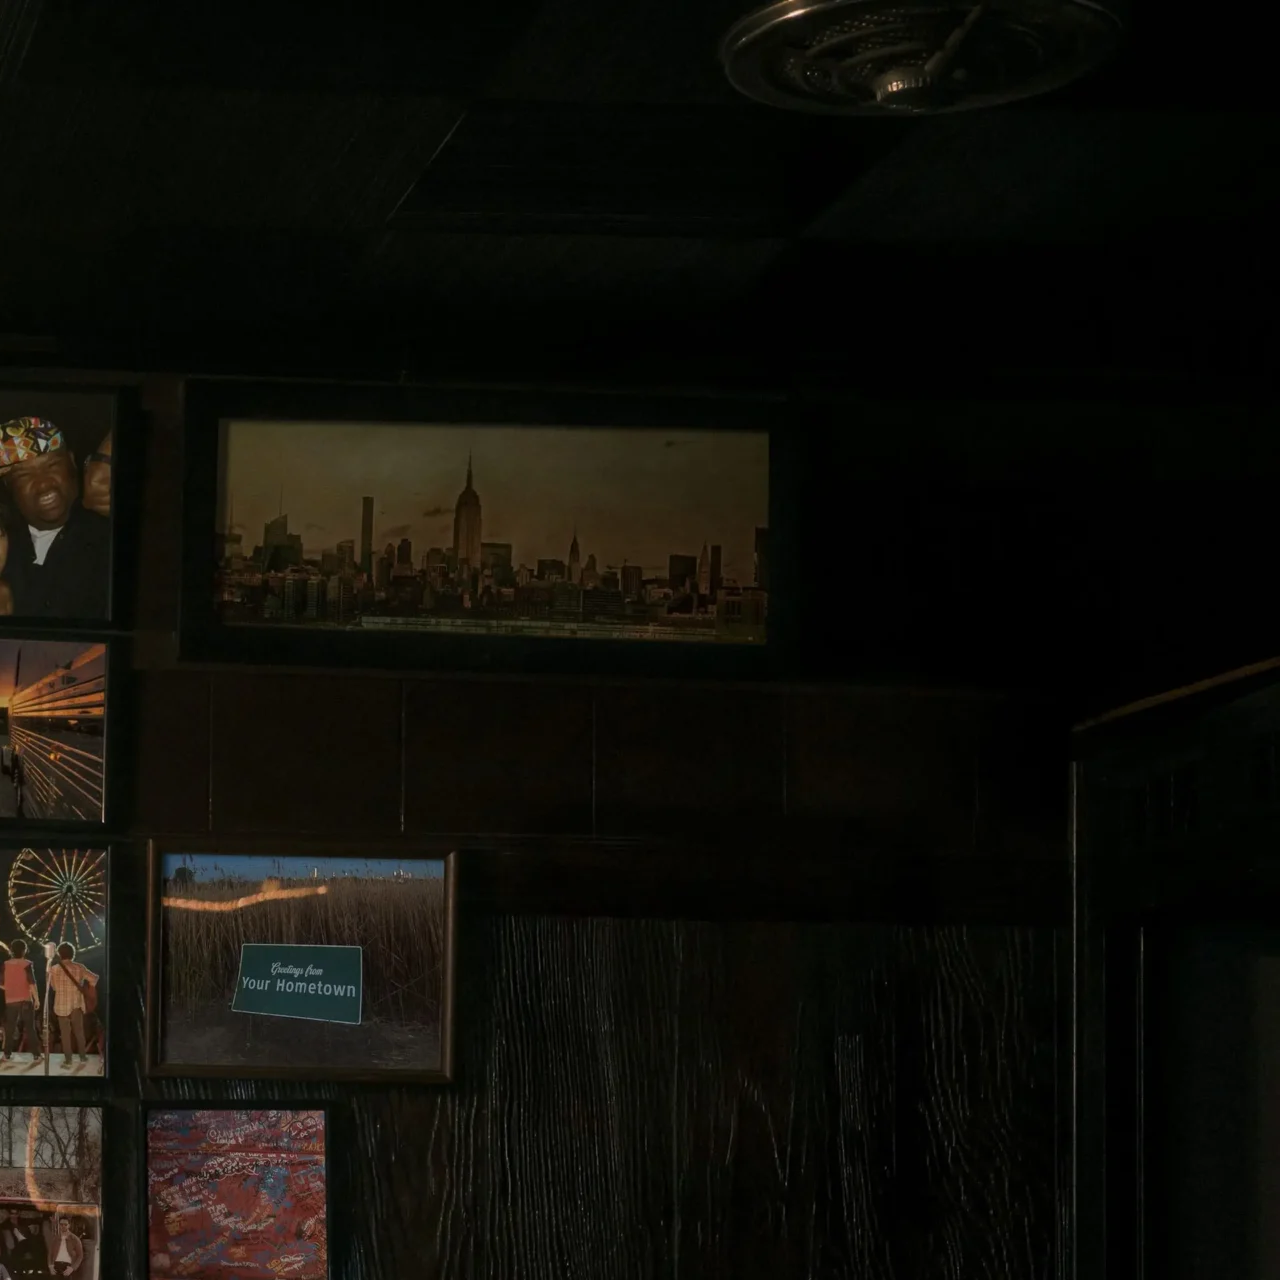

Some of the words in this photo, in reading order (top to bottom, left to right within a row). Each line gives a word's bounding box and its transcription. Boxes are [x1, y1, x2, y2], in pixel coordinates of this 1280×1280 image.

[271, 962, 303, 978] Greetings
[304, 963, 323, 977] from
[242, 976, 271, 991] Your
[276, 978, 356, 997] Hometown
